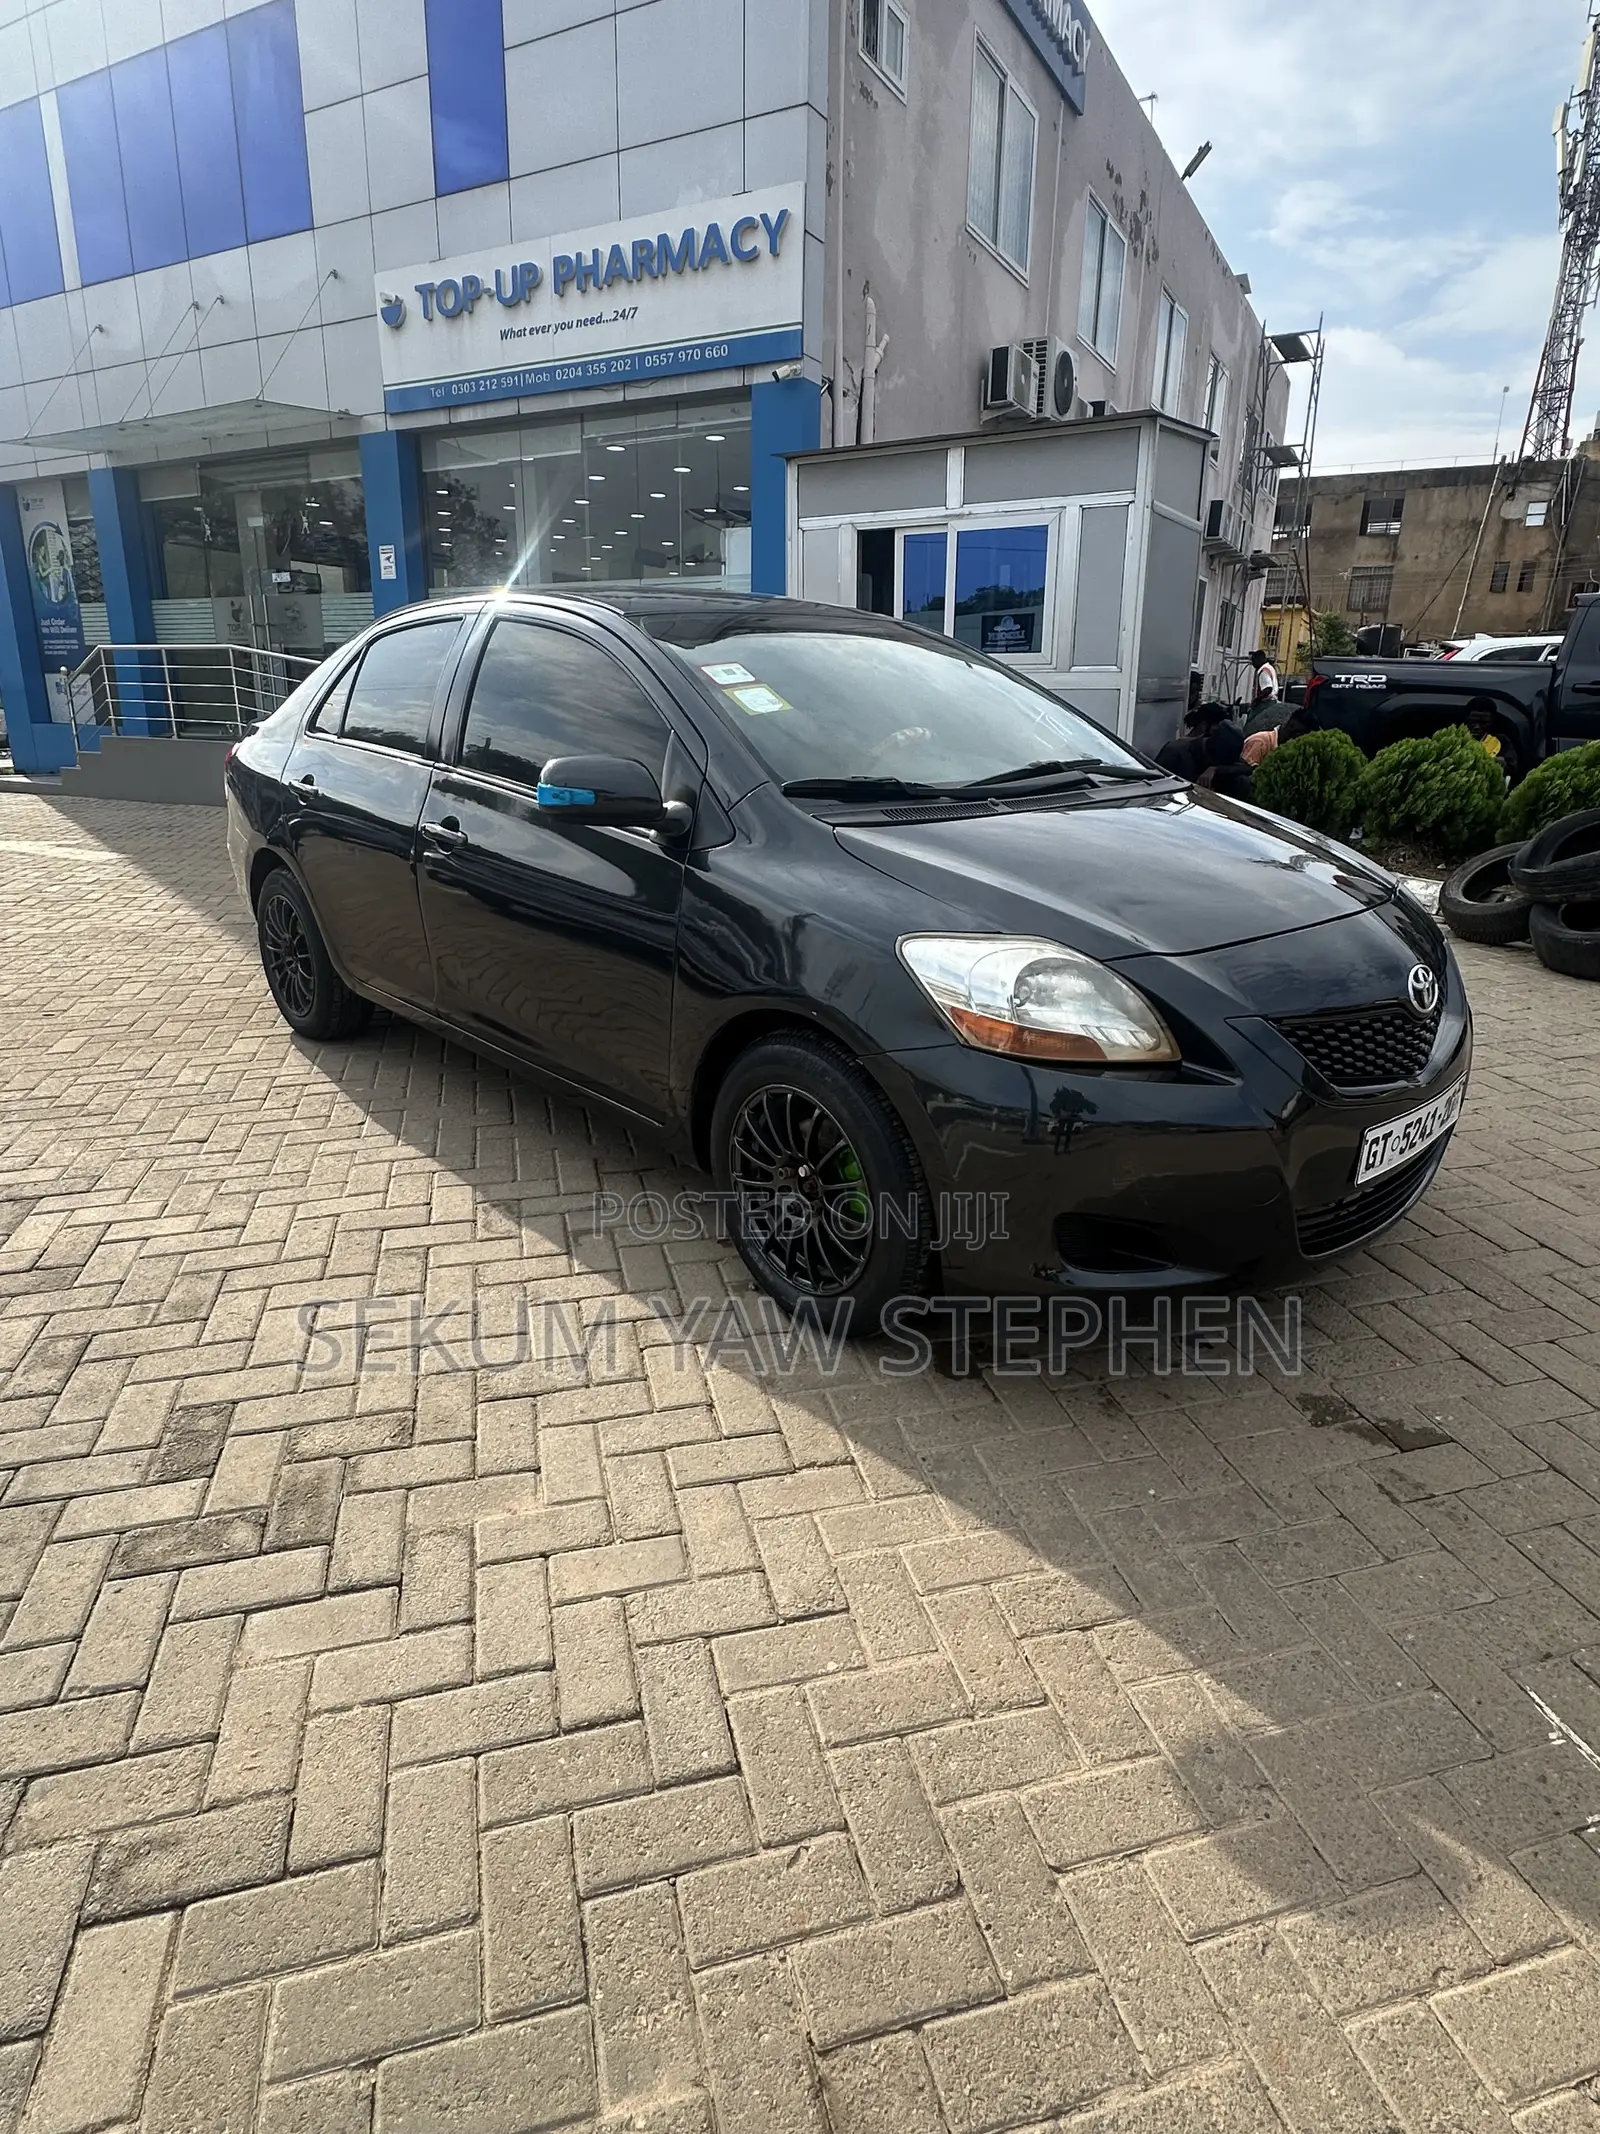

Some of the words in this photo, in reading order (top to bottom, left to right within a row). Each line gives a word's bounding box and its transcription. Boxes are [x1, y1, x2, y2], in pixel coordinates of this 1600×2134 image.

[414, 261, 543, 322] TOP-UP
[552, 208, 792, 297] PHARMACY
[499, 326, 527, 341] What
[528, 323, 553, 337] ever
[552, 319, 574, 335] you
[451, 382, 476, 396] 0303
[478, 378, 498, 392] 212
[555, 366, 583, 381] 0204
[586, 362, 607, 376] 355
[610, 358, 632, 373] 202
[644, 352, 674, 368] 0557
[678, 348, 701, 363] 970
[705, 344, 729, 359] 660
[1335, 674, 1388, 684] TRD
